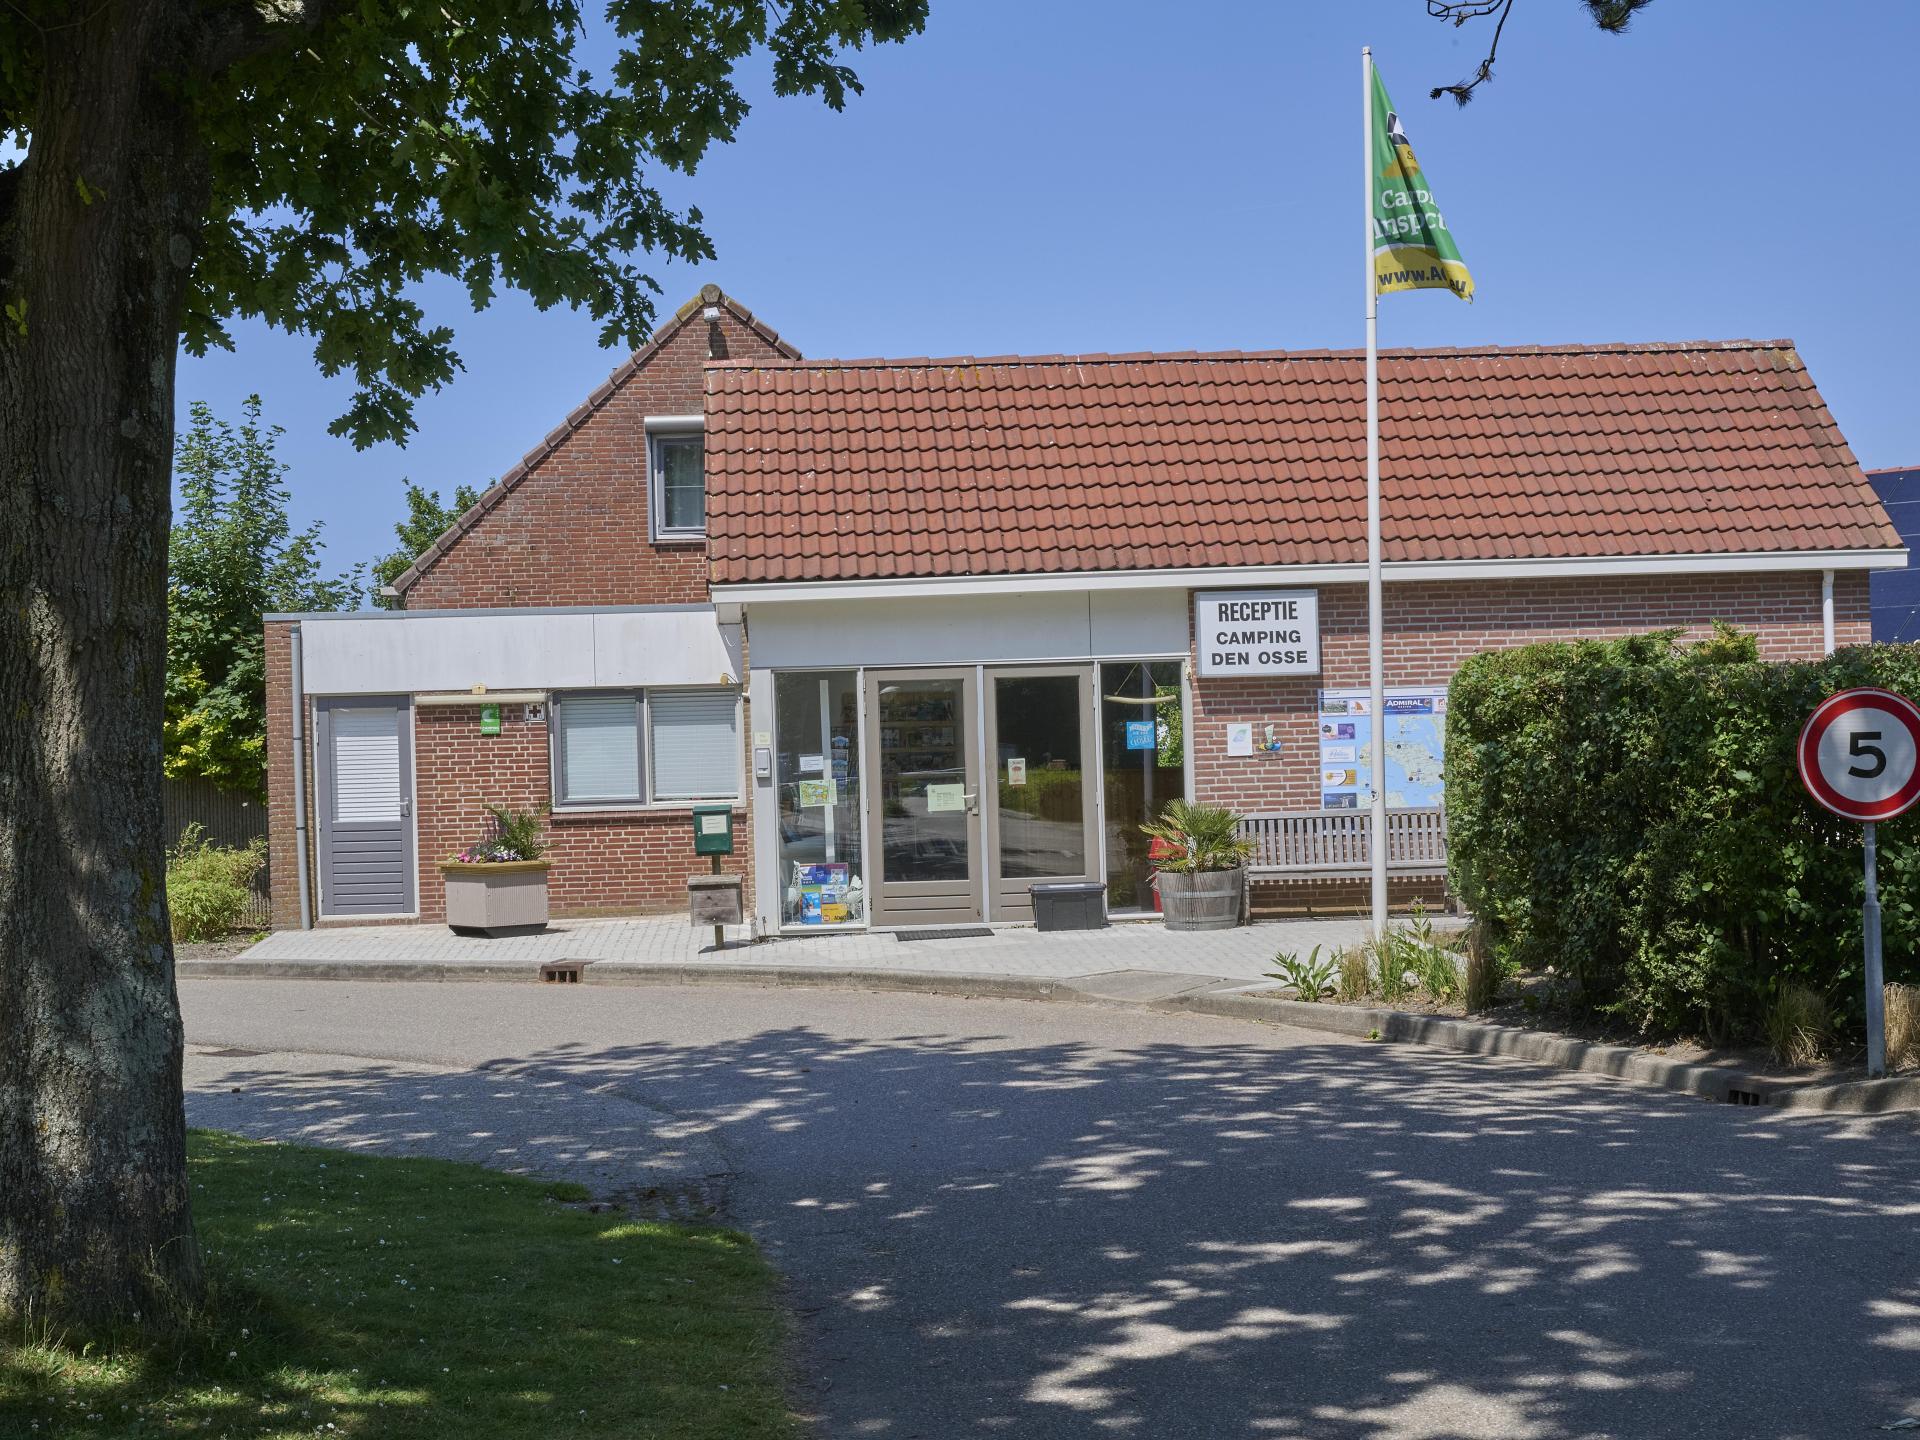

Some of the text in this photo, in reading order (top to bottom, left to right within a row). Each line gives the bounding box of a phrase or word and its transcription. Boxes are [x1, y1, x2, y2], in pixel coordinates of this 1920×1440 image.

[1218, 600, 1298, 622] RECEPTIE
[1216, 629, 1301, 645] CAMPING
[1211, 650, 1308, 666] DEN OSSE
[1386, 699, 1424, 707] ADMIRAL
[1848, 731, 1887, 779] 5
